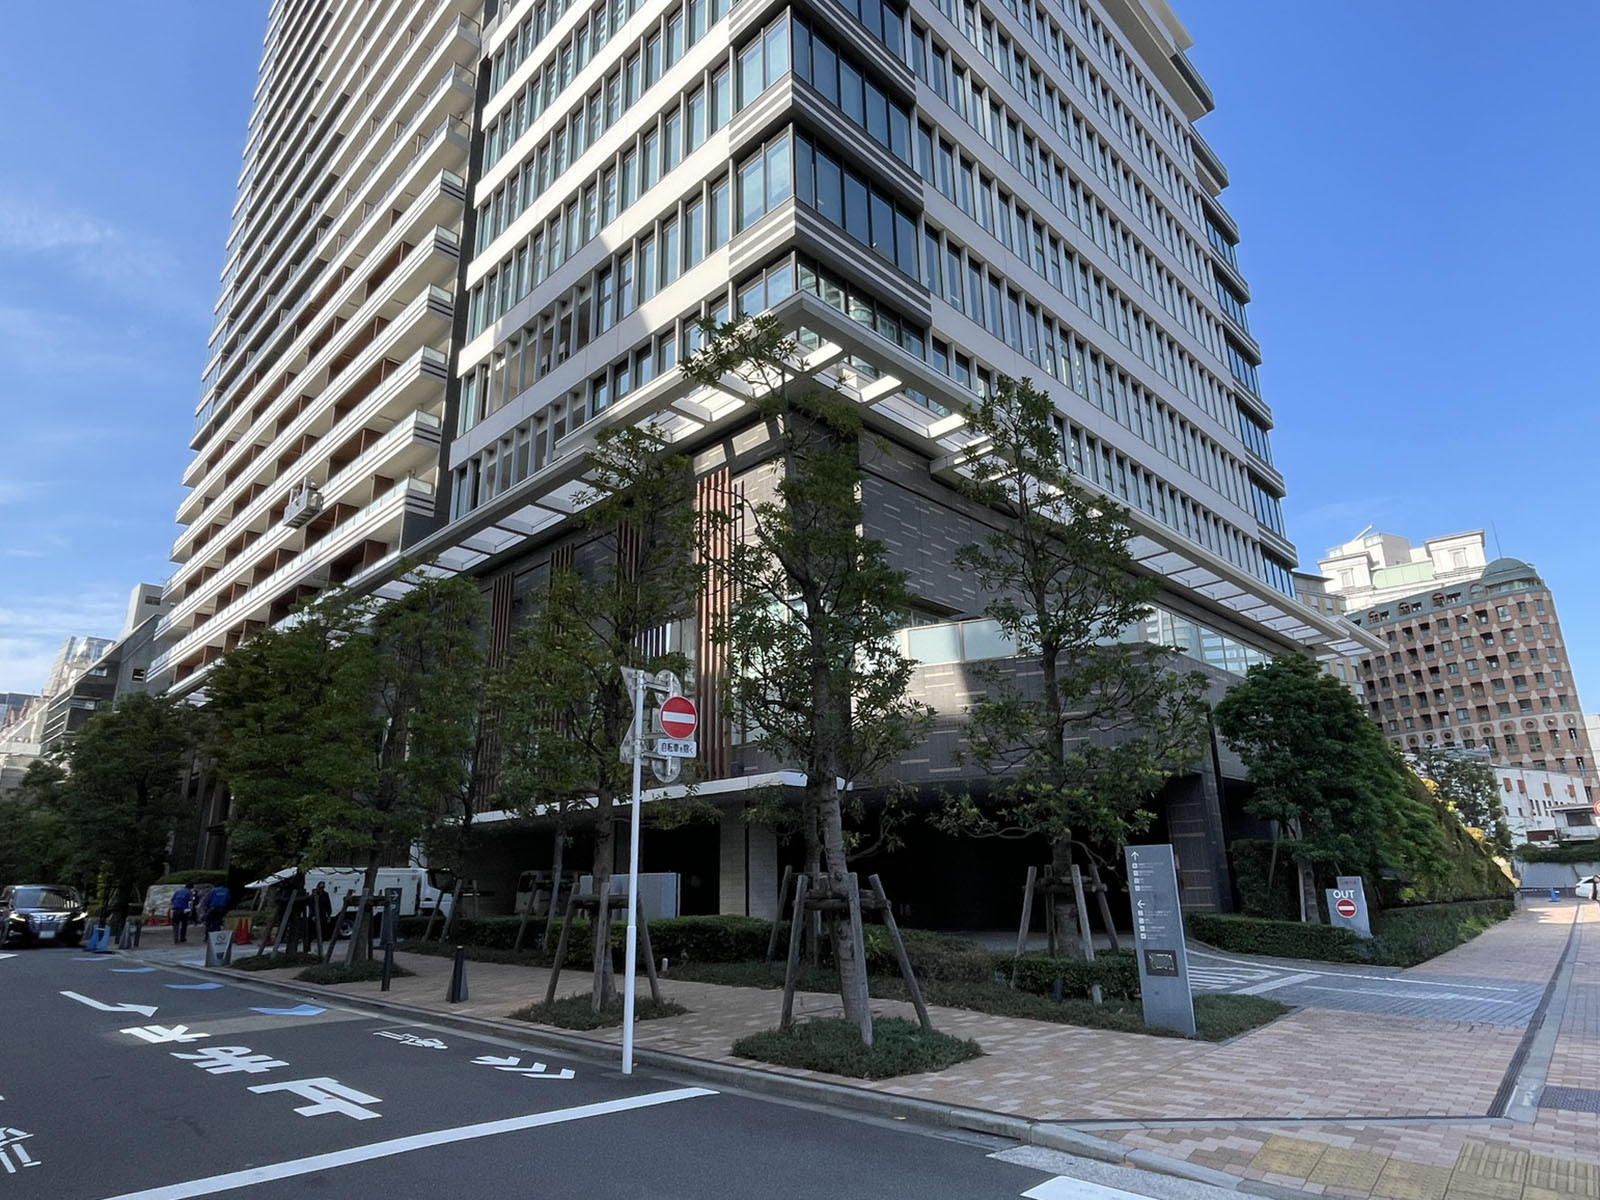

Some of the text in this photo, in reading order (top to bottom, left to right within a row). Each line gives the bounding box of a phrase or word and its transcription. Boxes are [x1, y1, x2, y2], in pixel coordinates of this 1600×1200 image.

[661, 742, 694, 754] 自転車を除く
[1333, 889, 1355, 899] OUT
[119, 1025, 383, 1120] 止まれ
